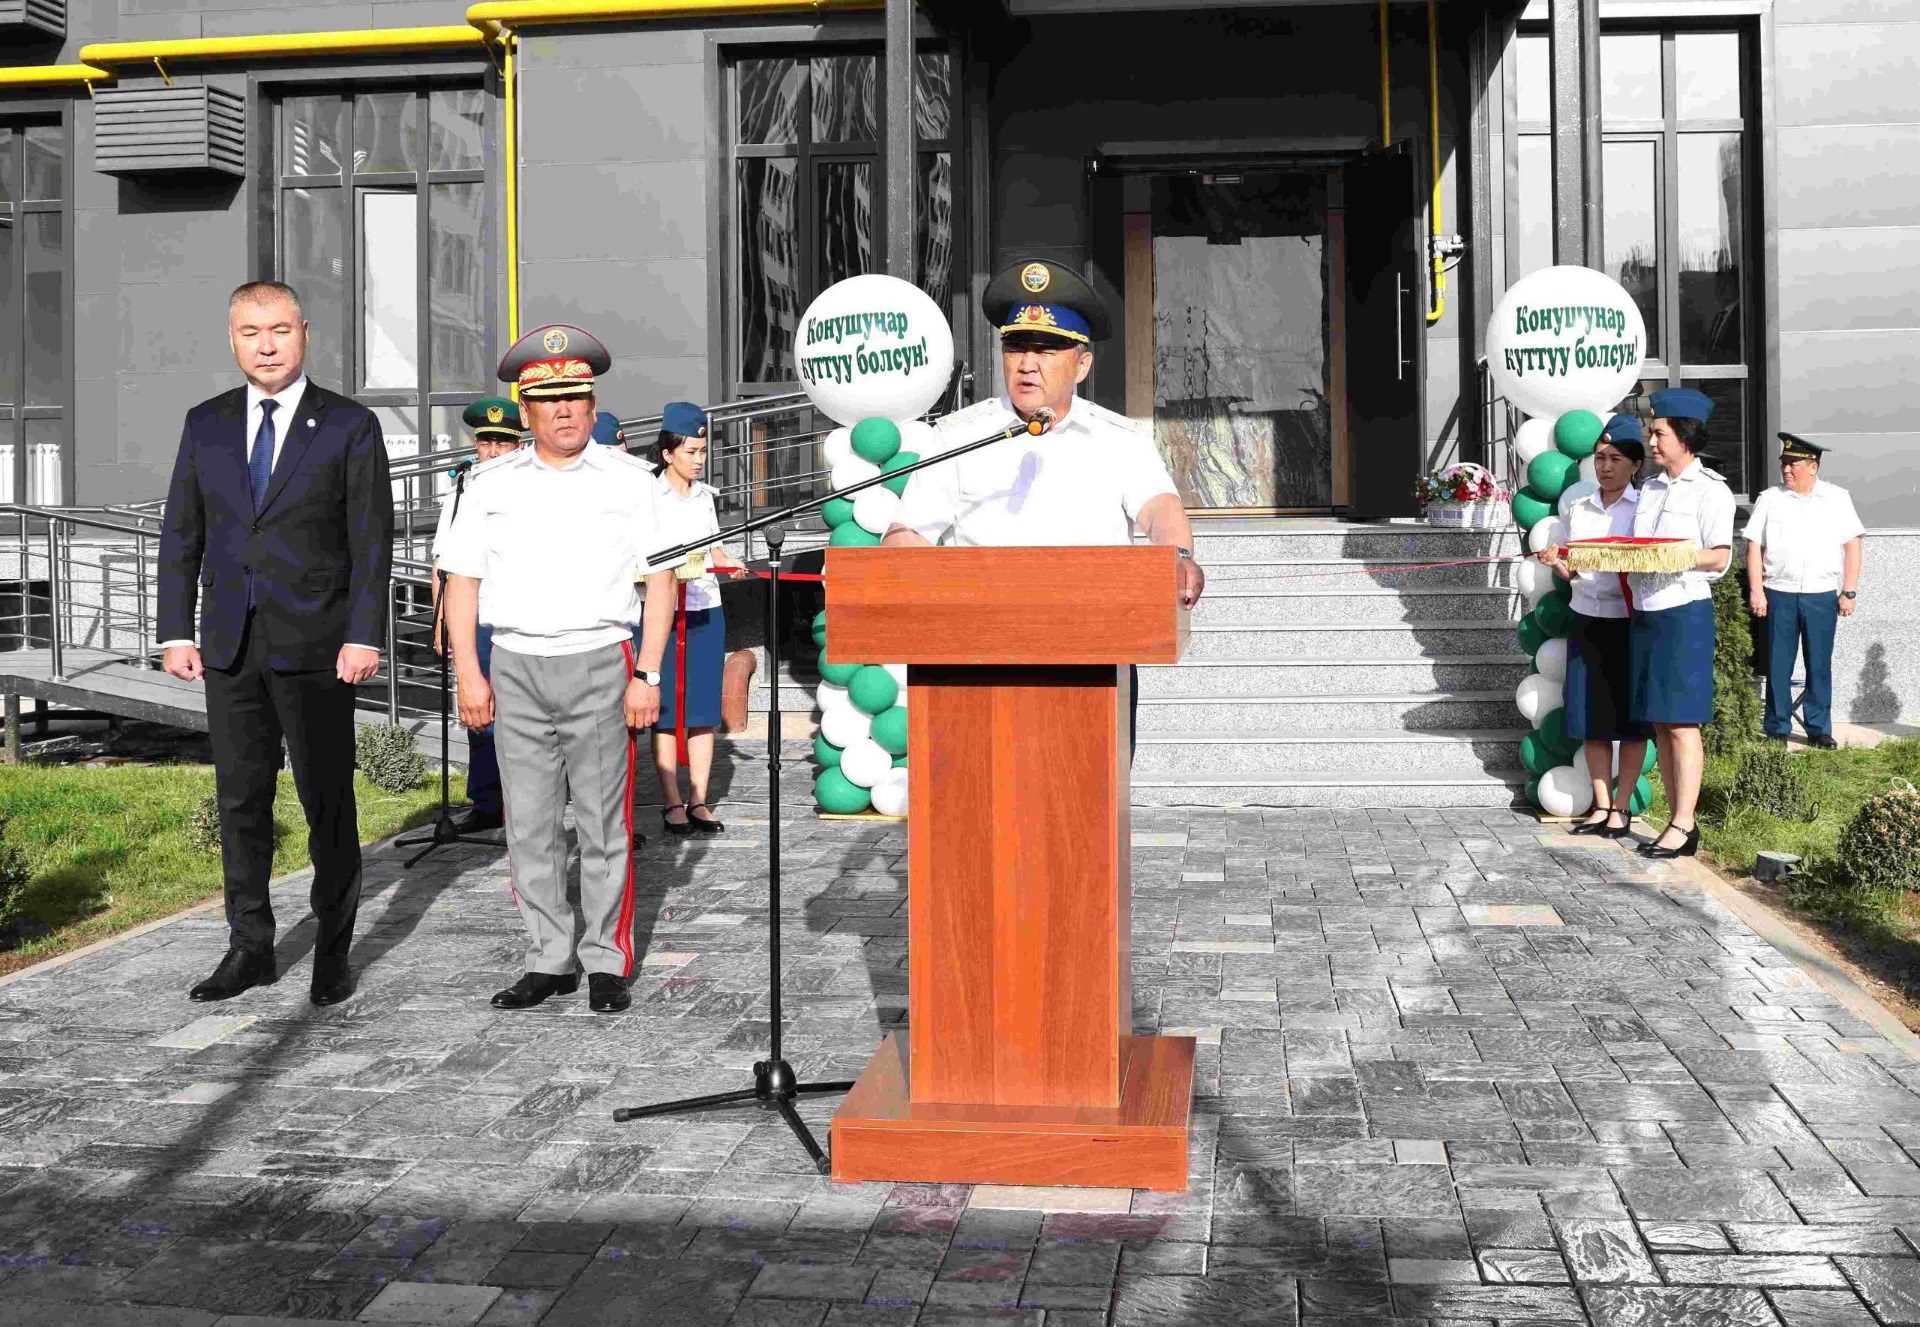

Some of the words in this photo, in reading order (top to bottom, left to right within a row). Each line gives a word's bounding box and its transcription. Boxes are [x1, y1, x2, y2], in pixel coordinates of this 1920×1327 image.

[806, 312, 908, 345] Конушуңар
[801, 354, 852, 386] куттуу
[856, 336, 928, 376] болсун!
[1504, 346, 1570, 377] куттуу
[1575, 335, 1638, 373] болсун!
